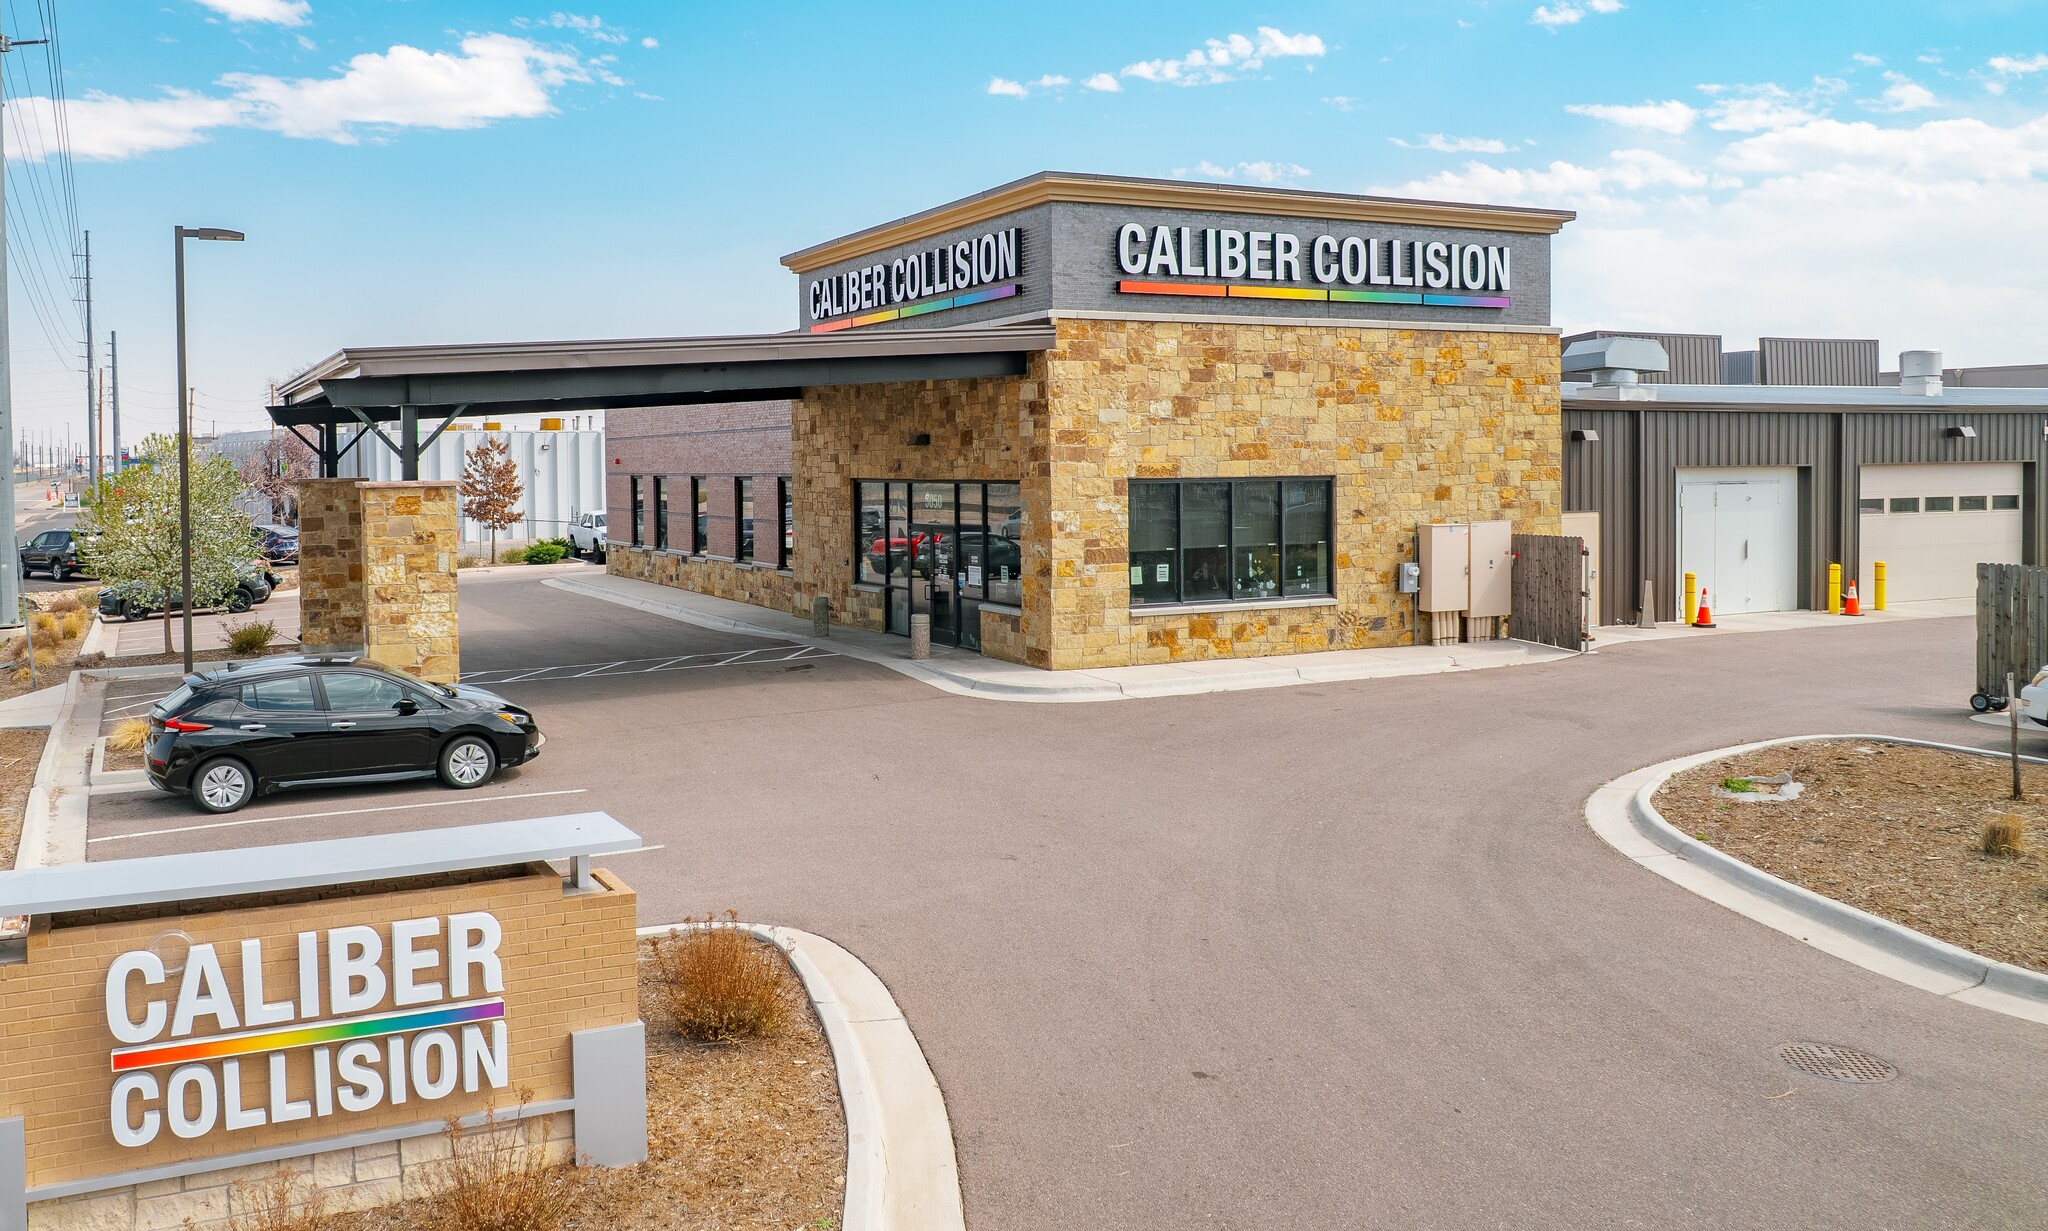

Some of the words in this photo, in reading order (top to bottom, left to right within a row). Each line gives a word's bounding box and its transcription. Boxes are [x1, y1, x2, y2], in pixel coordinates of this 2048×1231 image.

[810, 264, 886, 320] CALIBER
[892, 228, 1016, 302] COLLISION
[1118, 223, 1301, 281] CALIBER
[1313, 235, 1511, 290] COLLISION
[106, 911, 505, 1043] CALIBER
[111, 1021, 508, 1147] COLLISION
